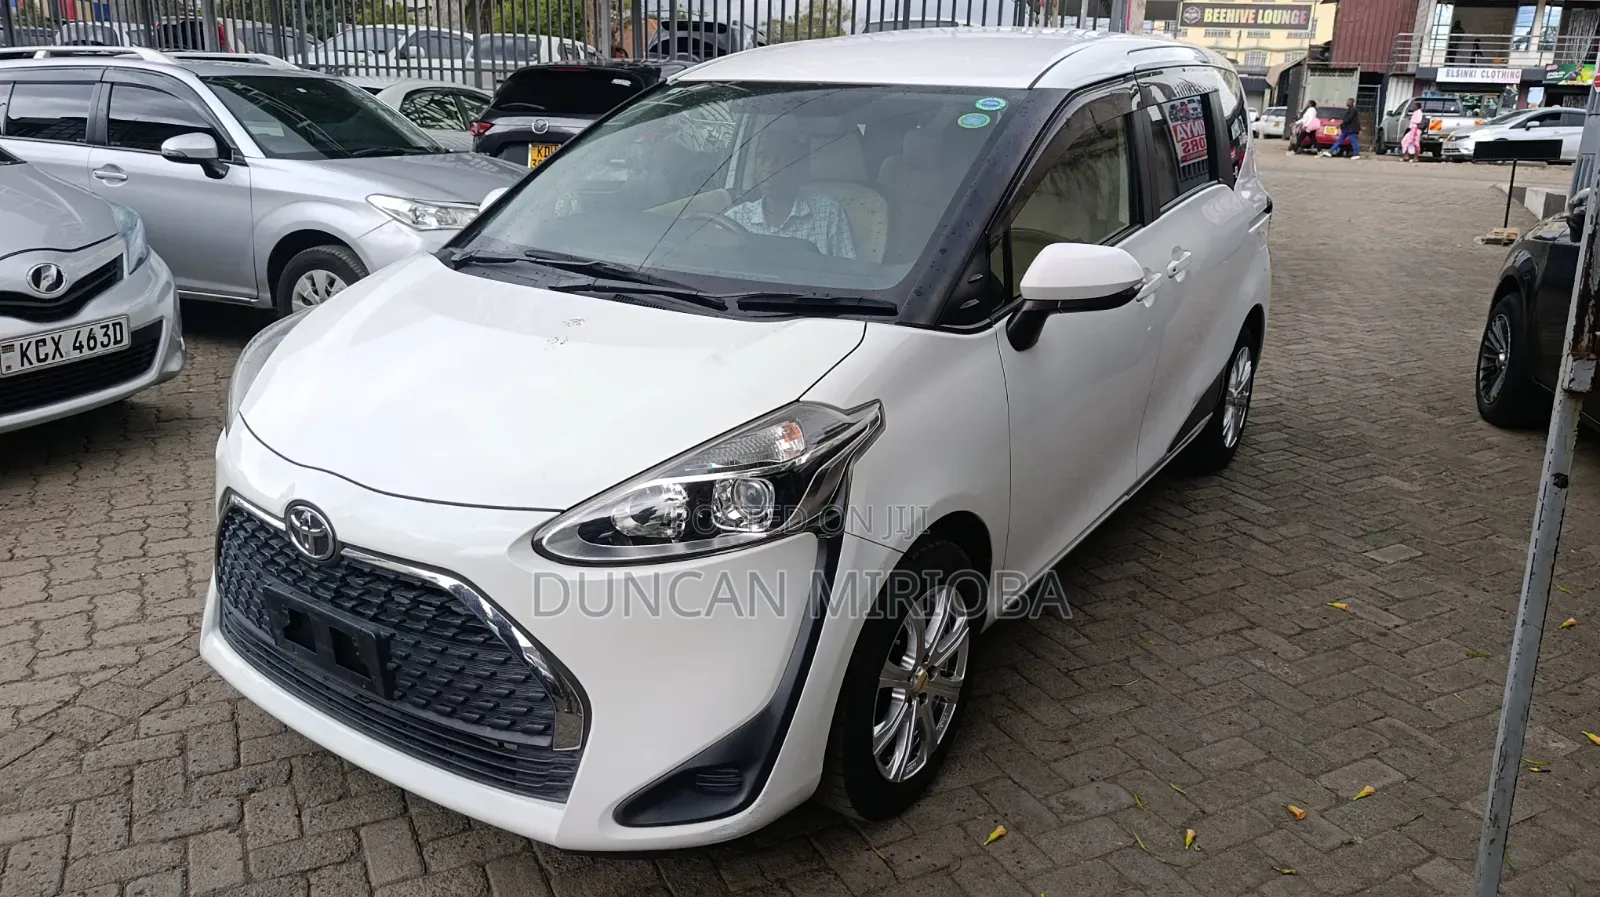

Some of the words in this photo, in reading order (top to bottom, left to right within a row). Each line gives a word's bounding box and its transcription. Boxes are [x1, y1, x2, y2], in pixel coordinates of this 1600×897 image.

[1203, 8, 1256, 24] BEEHIVE
[1257, 9, 1308, 25] LOUNGE
[1445, 69, 1477, 78] ELSINKI
[1480, 69, 1520, 79] CLOTHING
[20, 334, 64, 367] KCX
[72, 321, 124, 354] 463D
